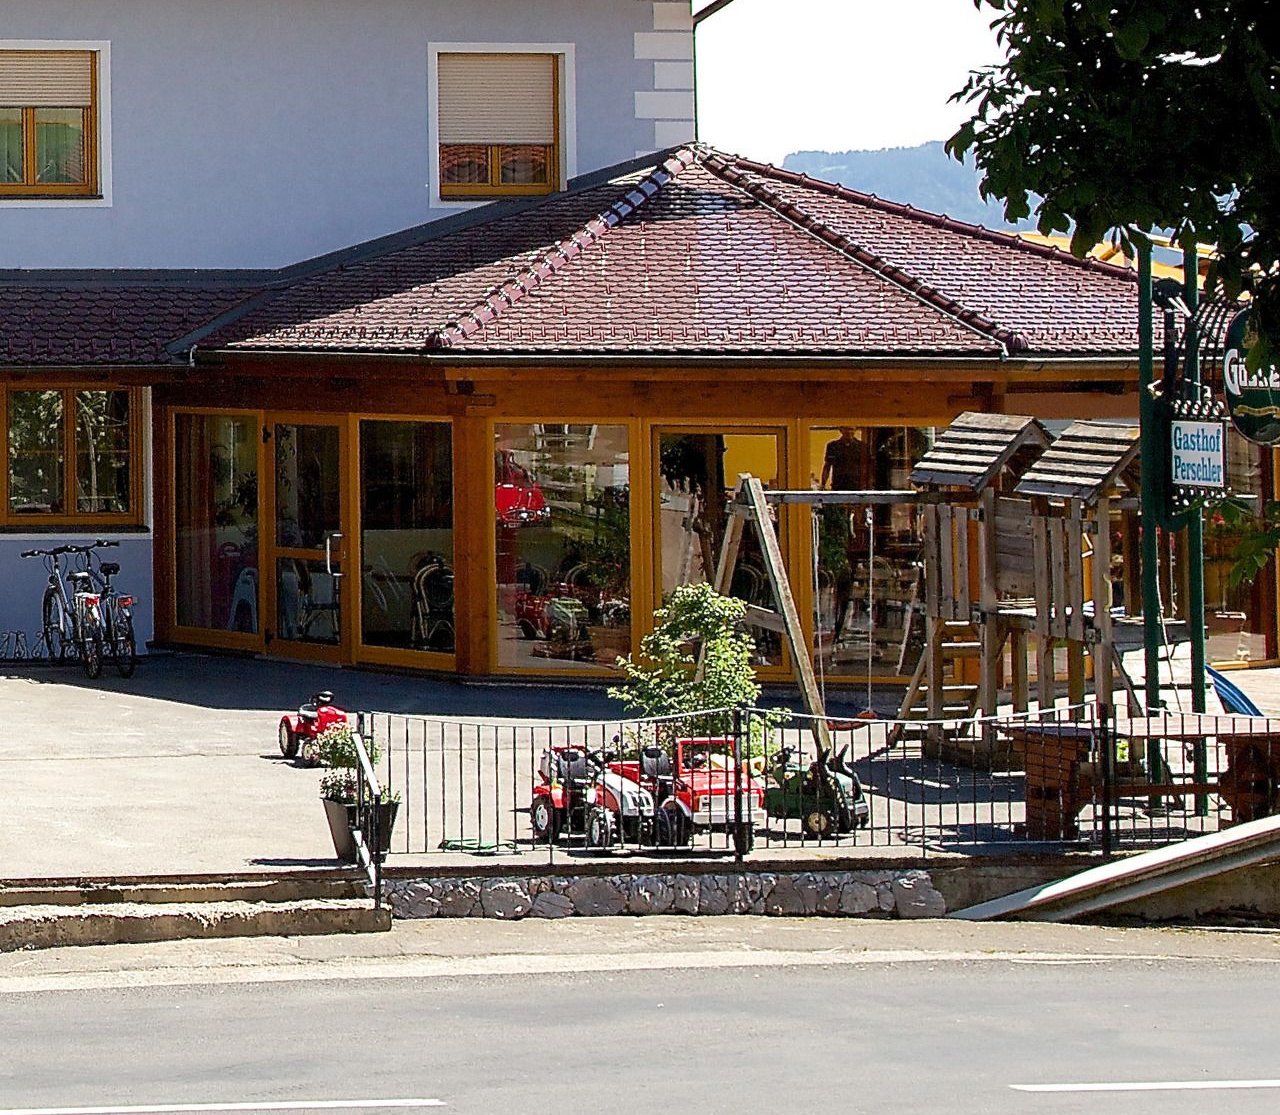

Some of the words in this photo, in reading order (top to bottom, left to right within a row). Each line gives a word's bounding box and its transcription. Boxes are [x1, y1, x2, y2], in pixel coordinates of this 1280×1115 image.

[1225, 348, 1280, 396] Göe
[1173, 426, 1221, 453] Gasthof
[1174, 455, 1221, 482] Perschler
